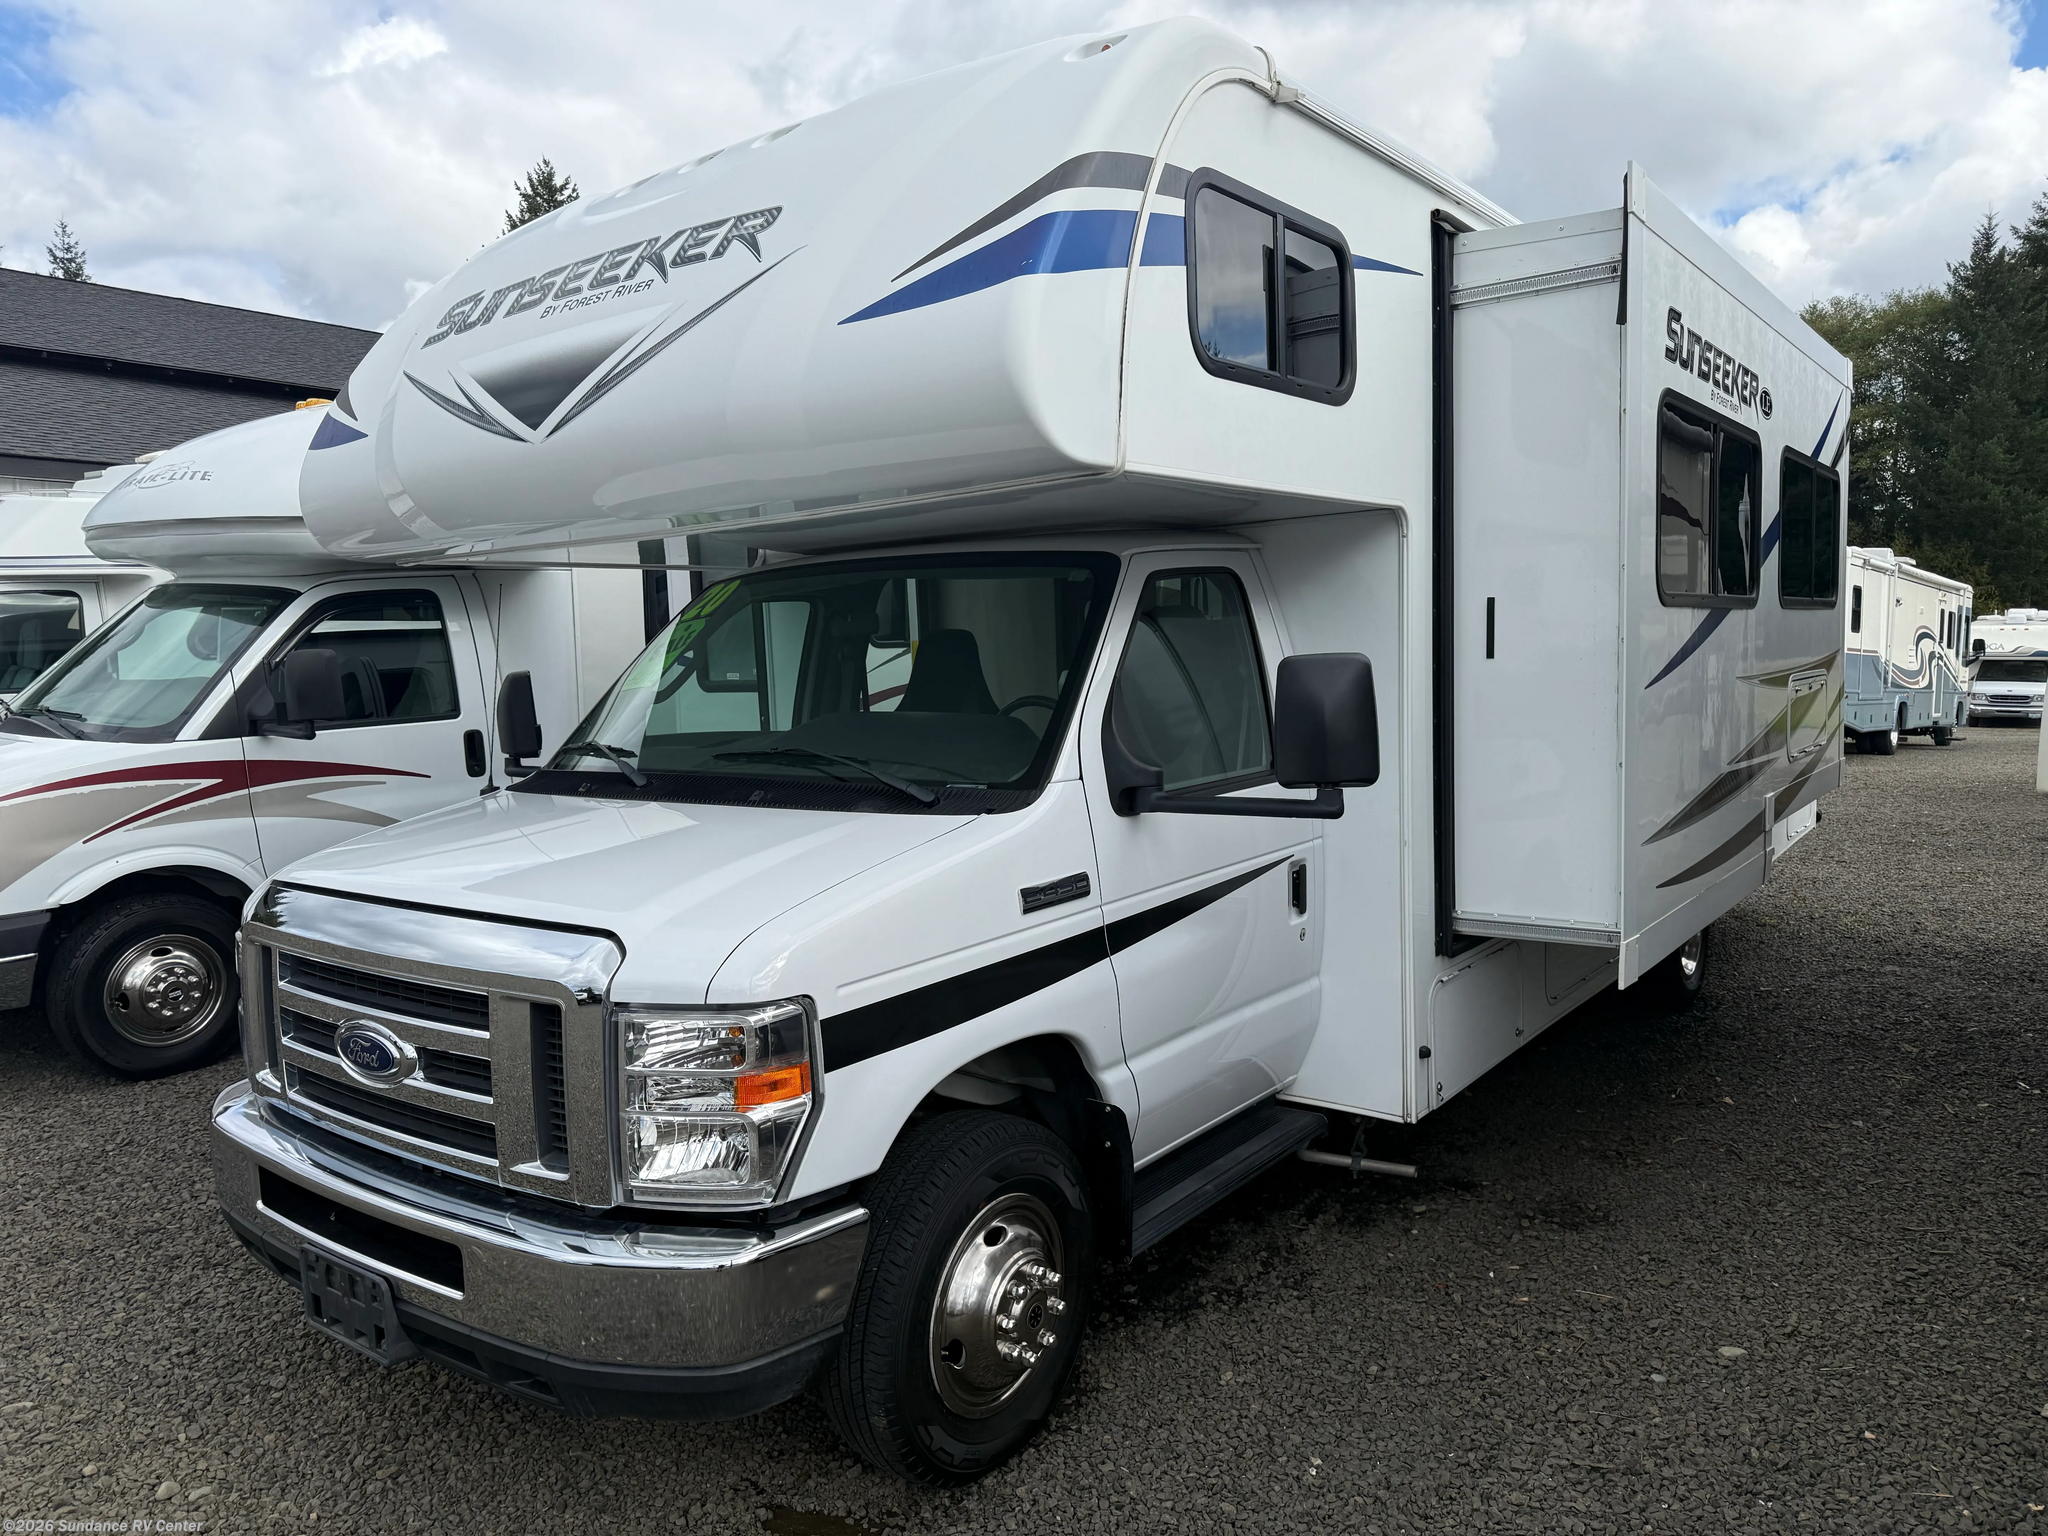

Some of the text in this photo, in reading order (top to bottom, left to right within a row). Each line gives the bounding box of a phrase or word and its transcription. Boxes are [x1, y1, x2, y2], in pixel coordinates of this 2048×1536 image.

[420, 205, 784, 350] SUNSEEKER
[539, 279, 654, 319] BY FOREST RIVER
[1664, 306, 1759, 424] SUNSEEKER
[348, 1037, 380, 1067] Ford
